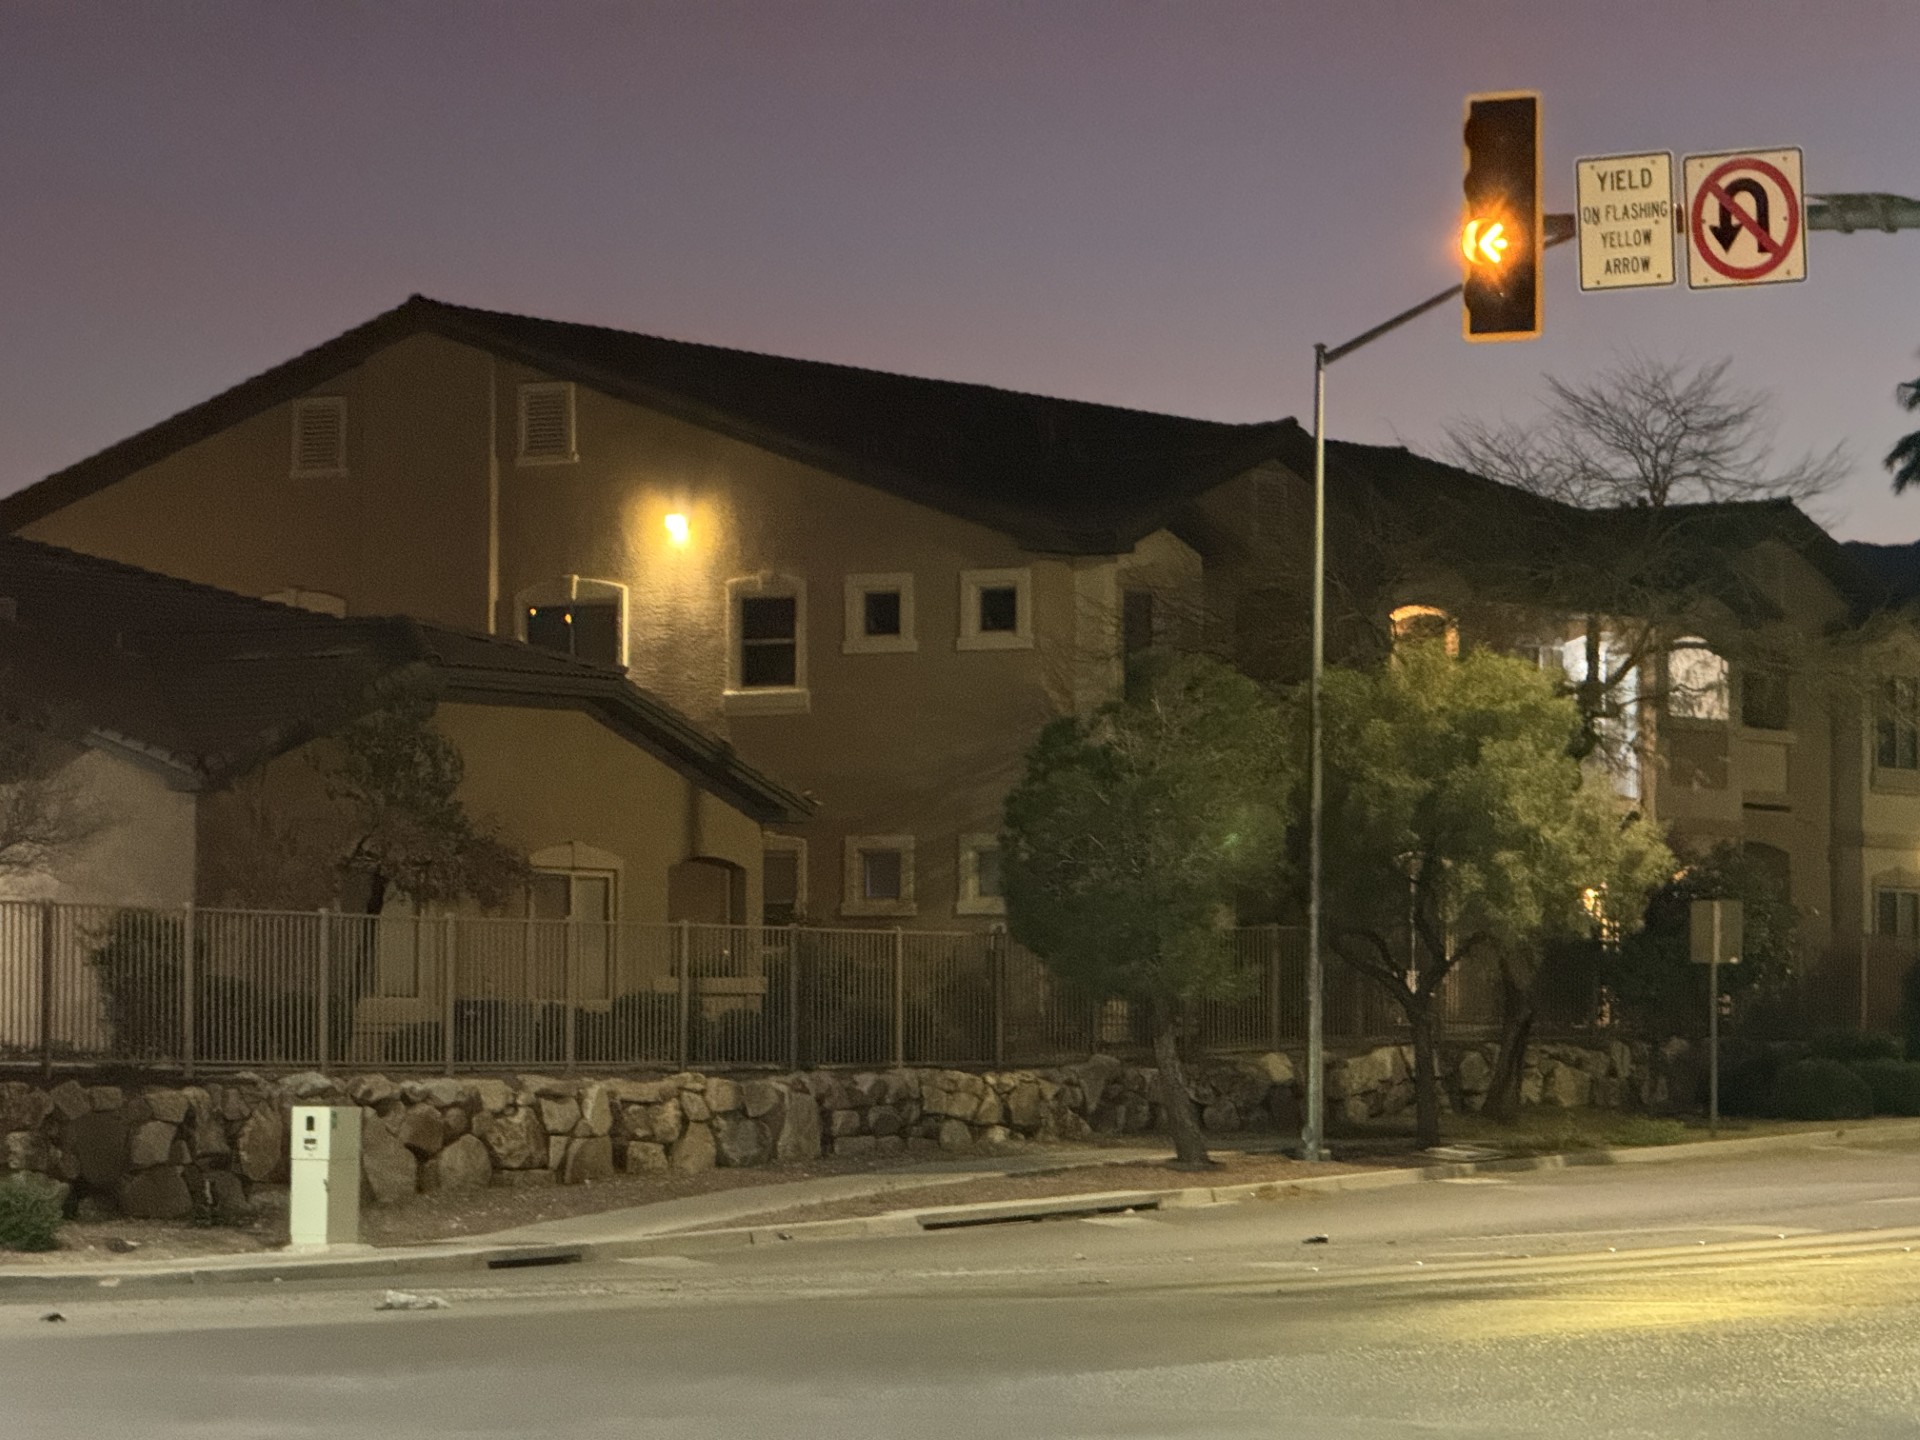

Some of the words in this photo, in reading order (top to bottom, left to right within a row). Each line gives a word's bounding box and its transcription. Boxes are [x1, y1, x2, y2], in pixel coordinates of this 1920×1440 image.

[1597, 168, 1652, 191] YIELD
[1584, 207, 1600, 224] ON
[1605, 201, 1668, 221] FLASHING
[1601, 229, 1652, 248] YELLOW
[1605, 257, 1650, 275] ARROW
